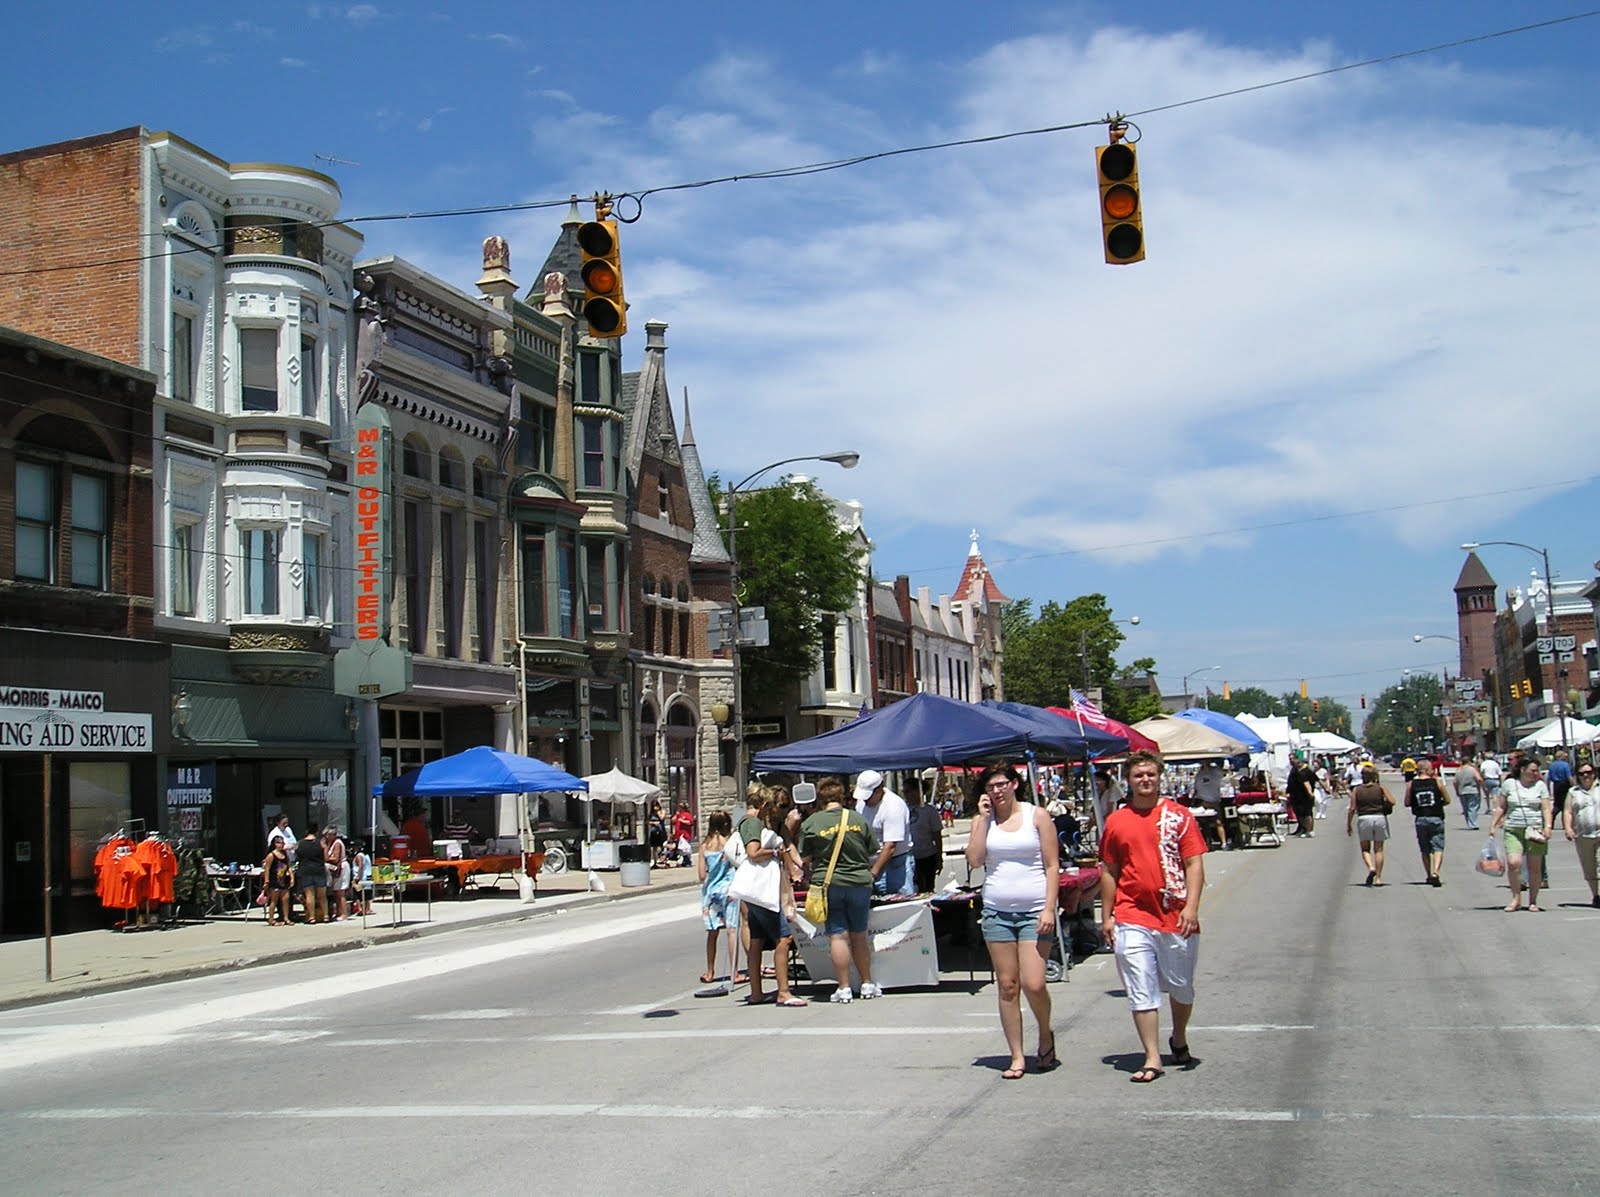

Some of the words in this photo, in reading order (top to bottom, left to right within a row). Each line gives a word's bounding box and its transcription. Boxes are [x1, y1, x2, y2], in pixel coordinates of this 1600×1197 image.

[356, 428, 379, 475] M&R
[357, 486, 379, 640] OUTFITTERS
[1538, 640, 1551, 650] 29
[1556, 638, 1574, 648] 703
[0, 689, 49, 707] MORRIS
[60, 693, 102, 710] MAICO
[0, 722, 33, 746] ING
[40, 723, 75, 746] AID
[80, 724, 147, 747] SERVICE
[194, 768, 201, 784] R
[167, 788, 212, 805] OUTFITTERS
